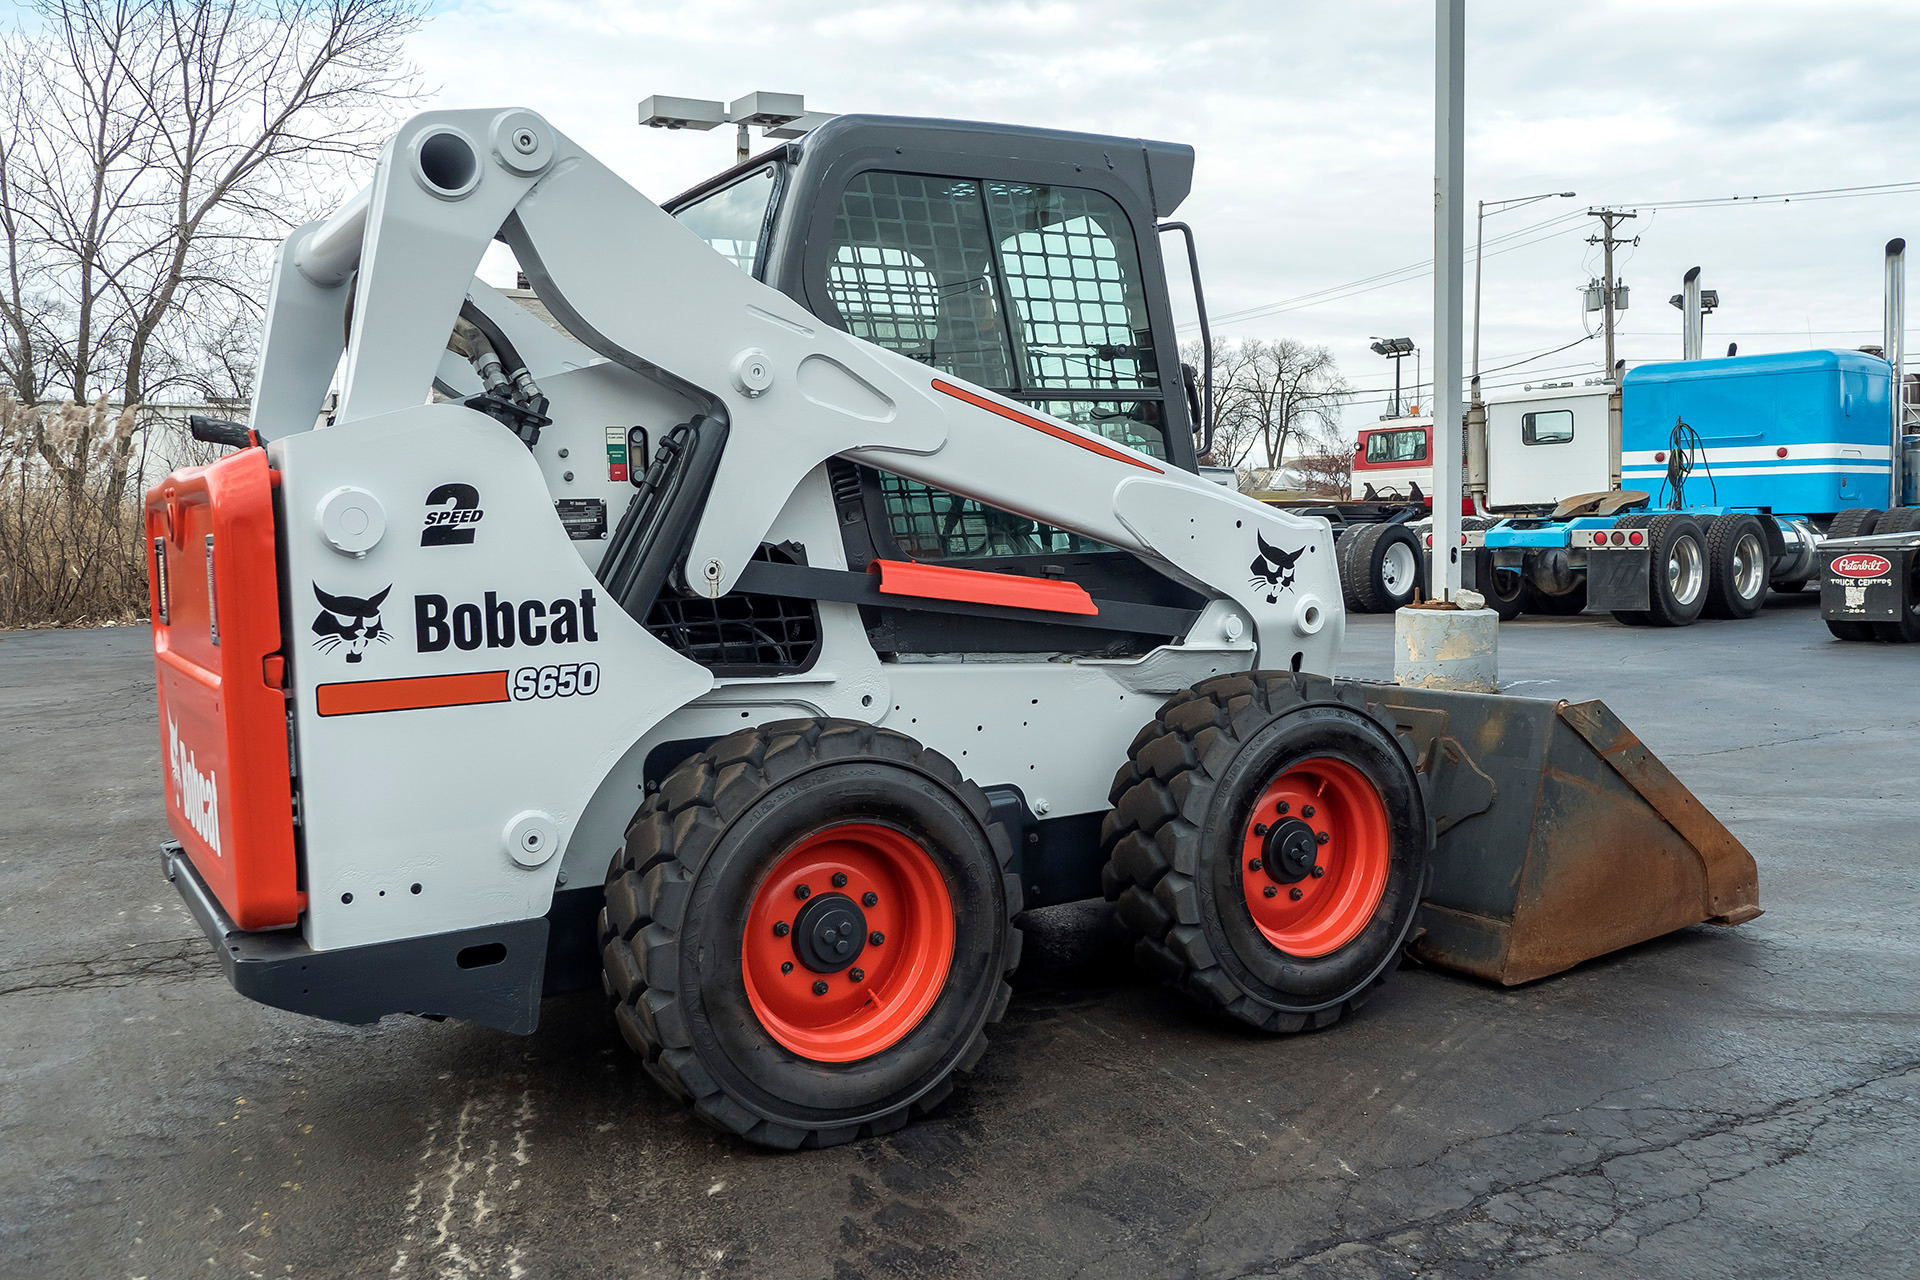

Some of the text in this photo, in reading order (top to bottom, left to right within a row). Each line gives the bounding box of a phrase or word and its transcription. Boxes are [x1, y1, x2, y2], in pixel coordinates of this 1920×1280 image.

[420, 482, 480, 547] 2
[424, 509, 484, 526] SPEED
[1838, 558, 1886, 572] Peterbilt
[414, 588, 599, 653] Bobcat
[513, 662, 600, 701] S650
[179, 739, 222, 858] Bobcat
